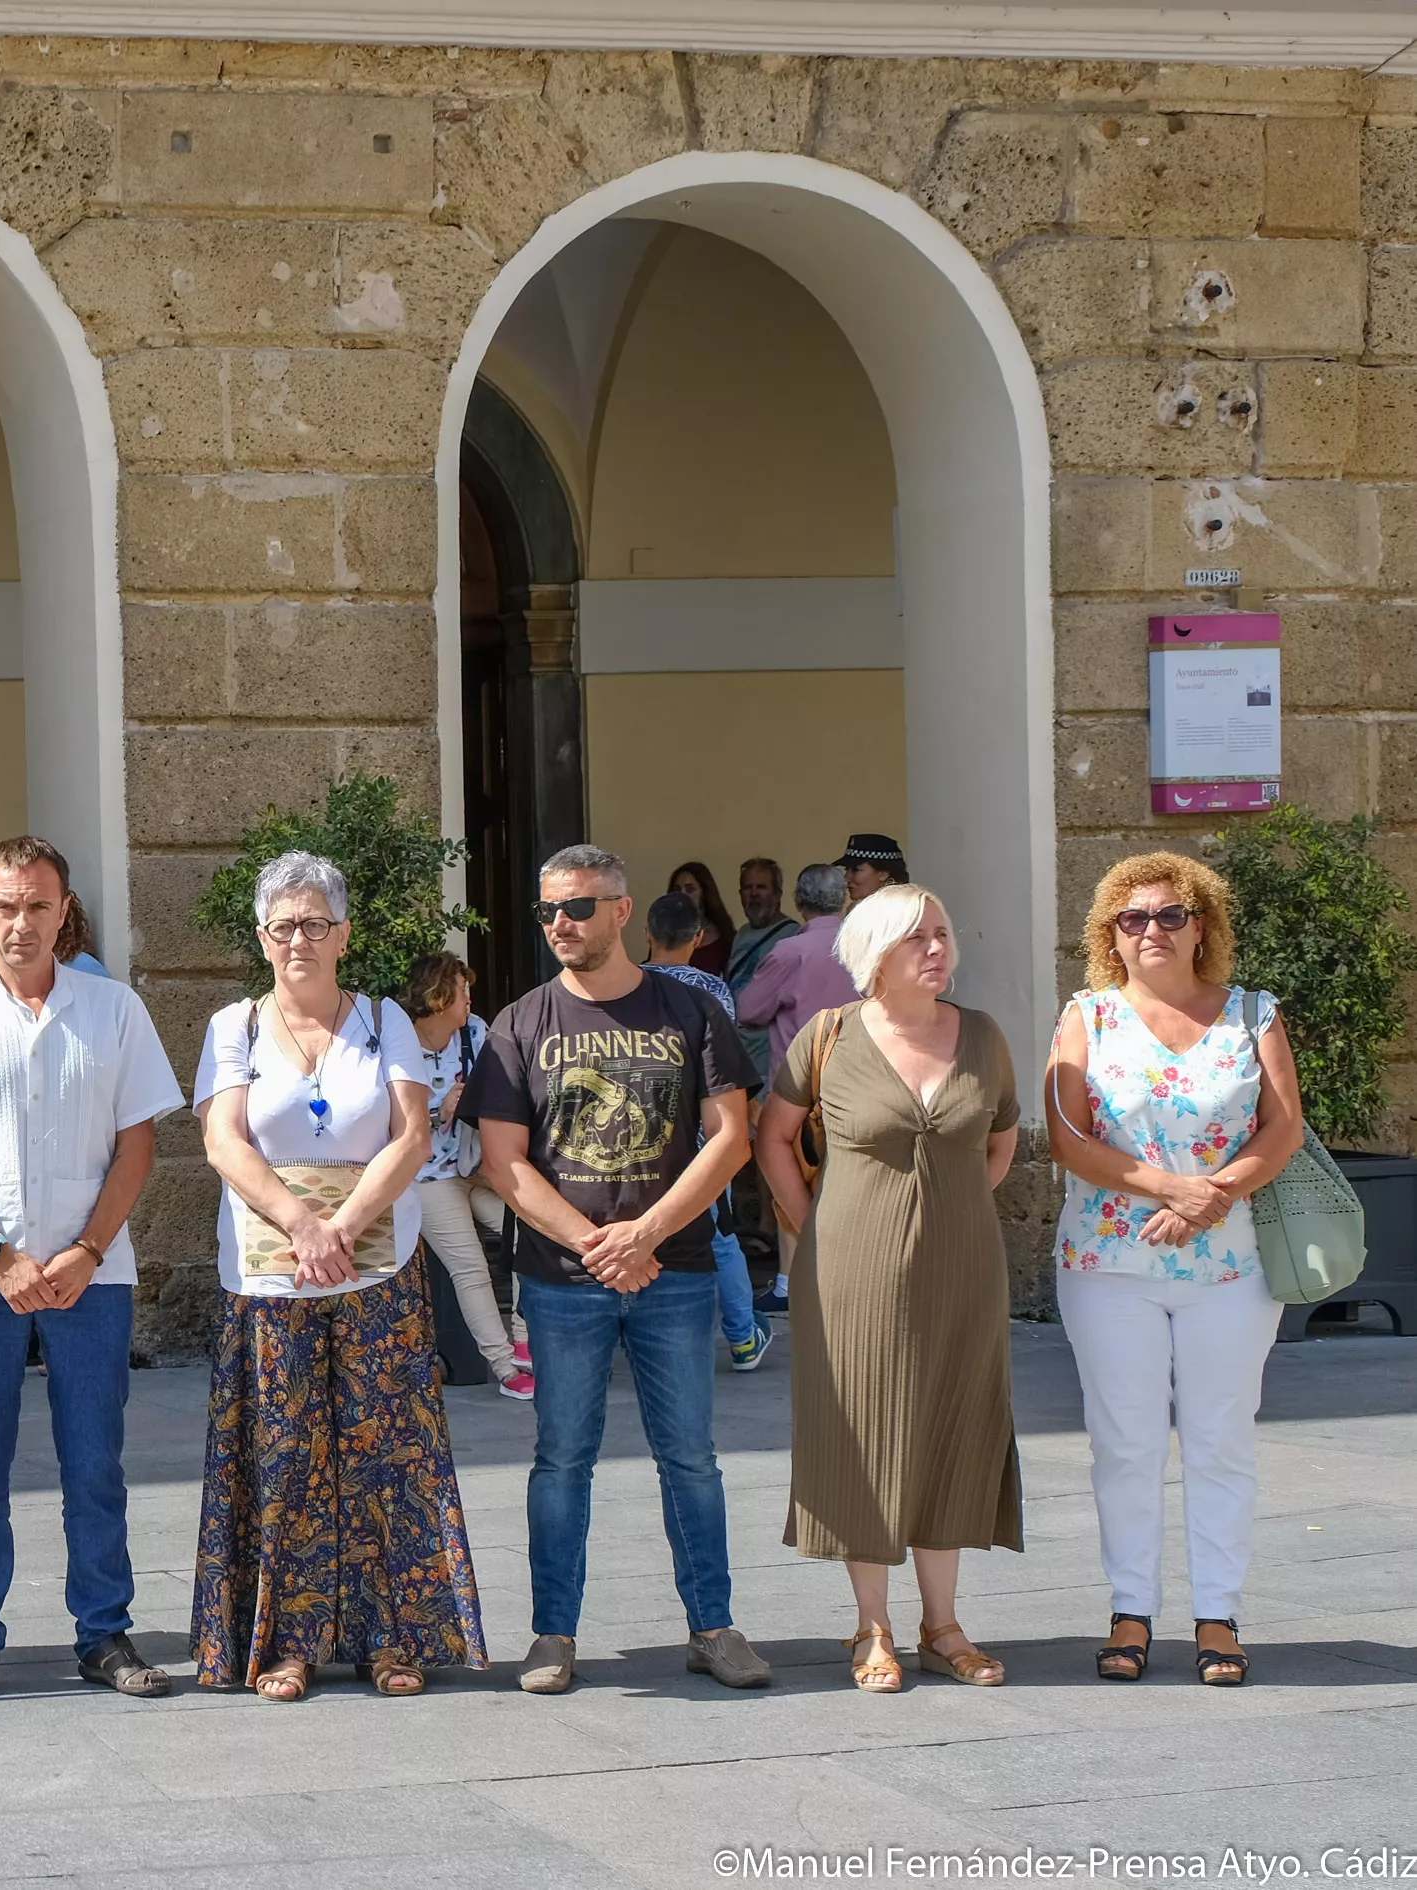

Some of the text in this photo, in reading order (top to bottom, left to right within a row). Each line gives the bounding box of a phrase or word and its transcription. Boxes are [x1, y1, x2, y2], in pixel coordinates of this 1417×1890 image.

[1189, 571, 1238, 583] 09628
[1175, 667, 1239, 680] Ayuntamiento
[539, 1030, 685, 1071] GUINNESS
[630, 1172, 660, 1182] DUBLIN
